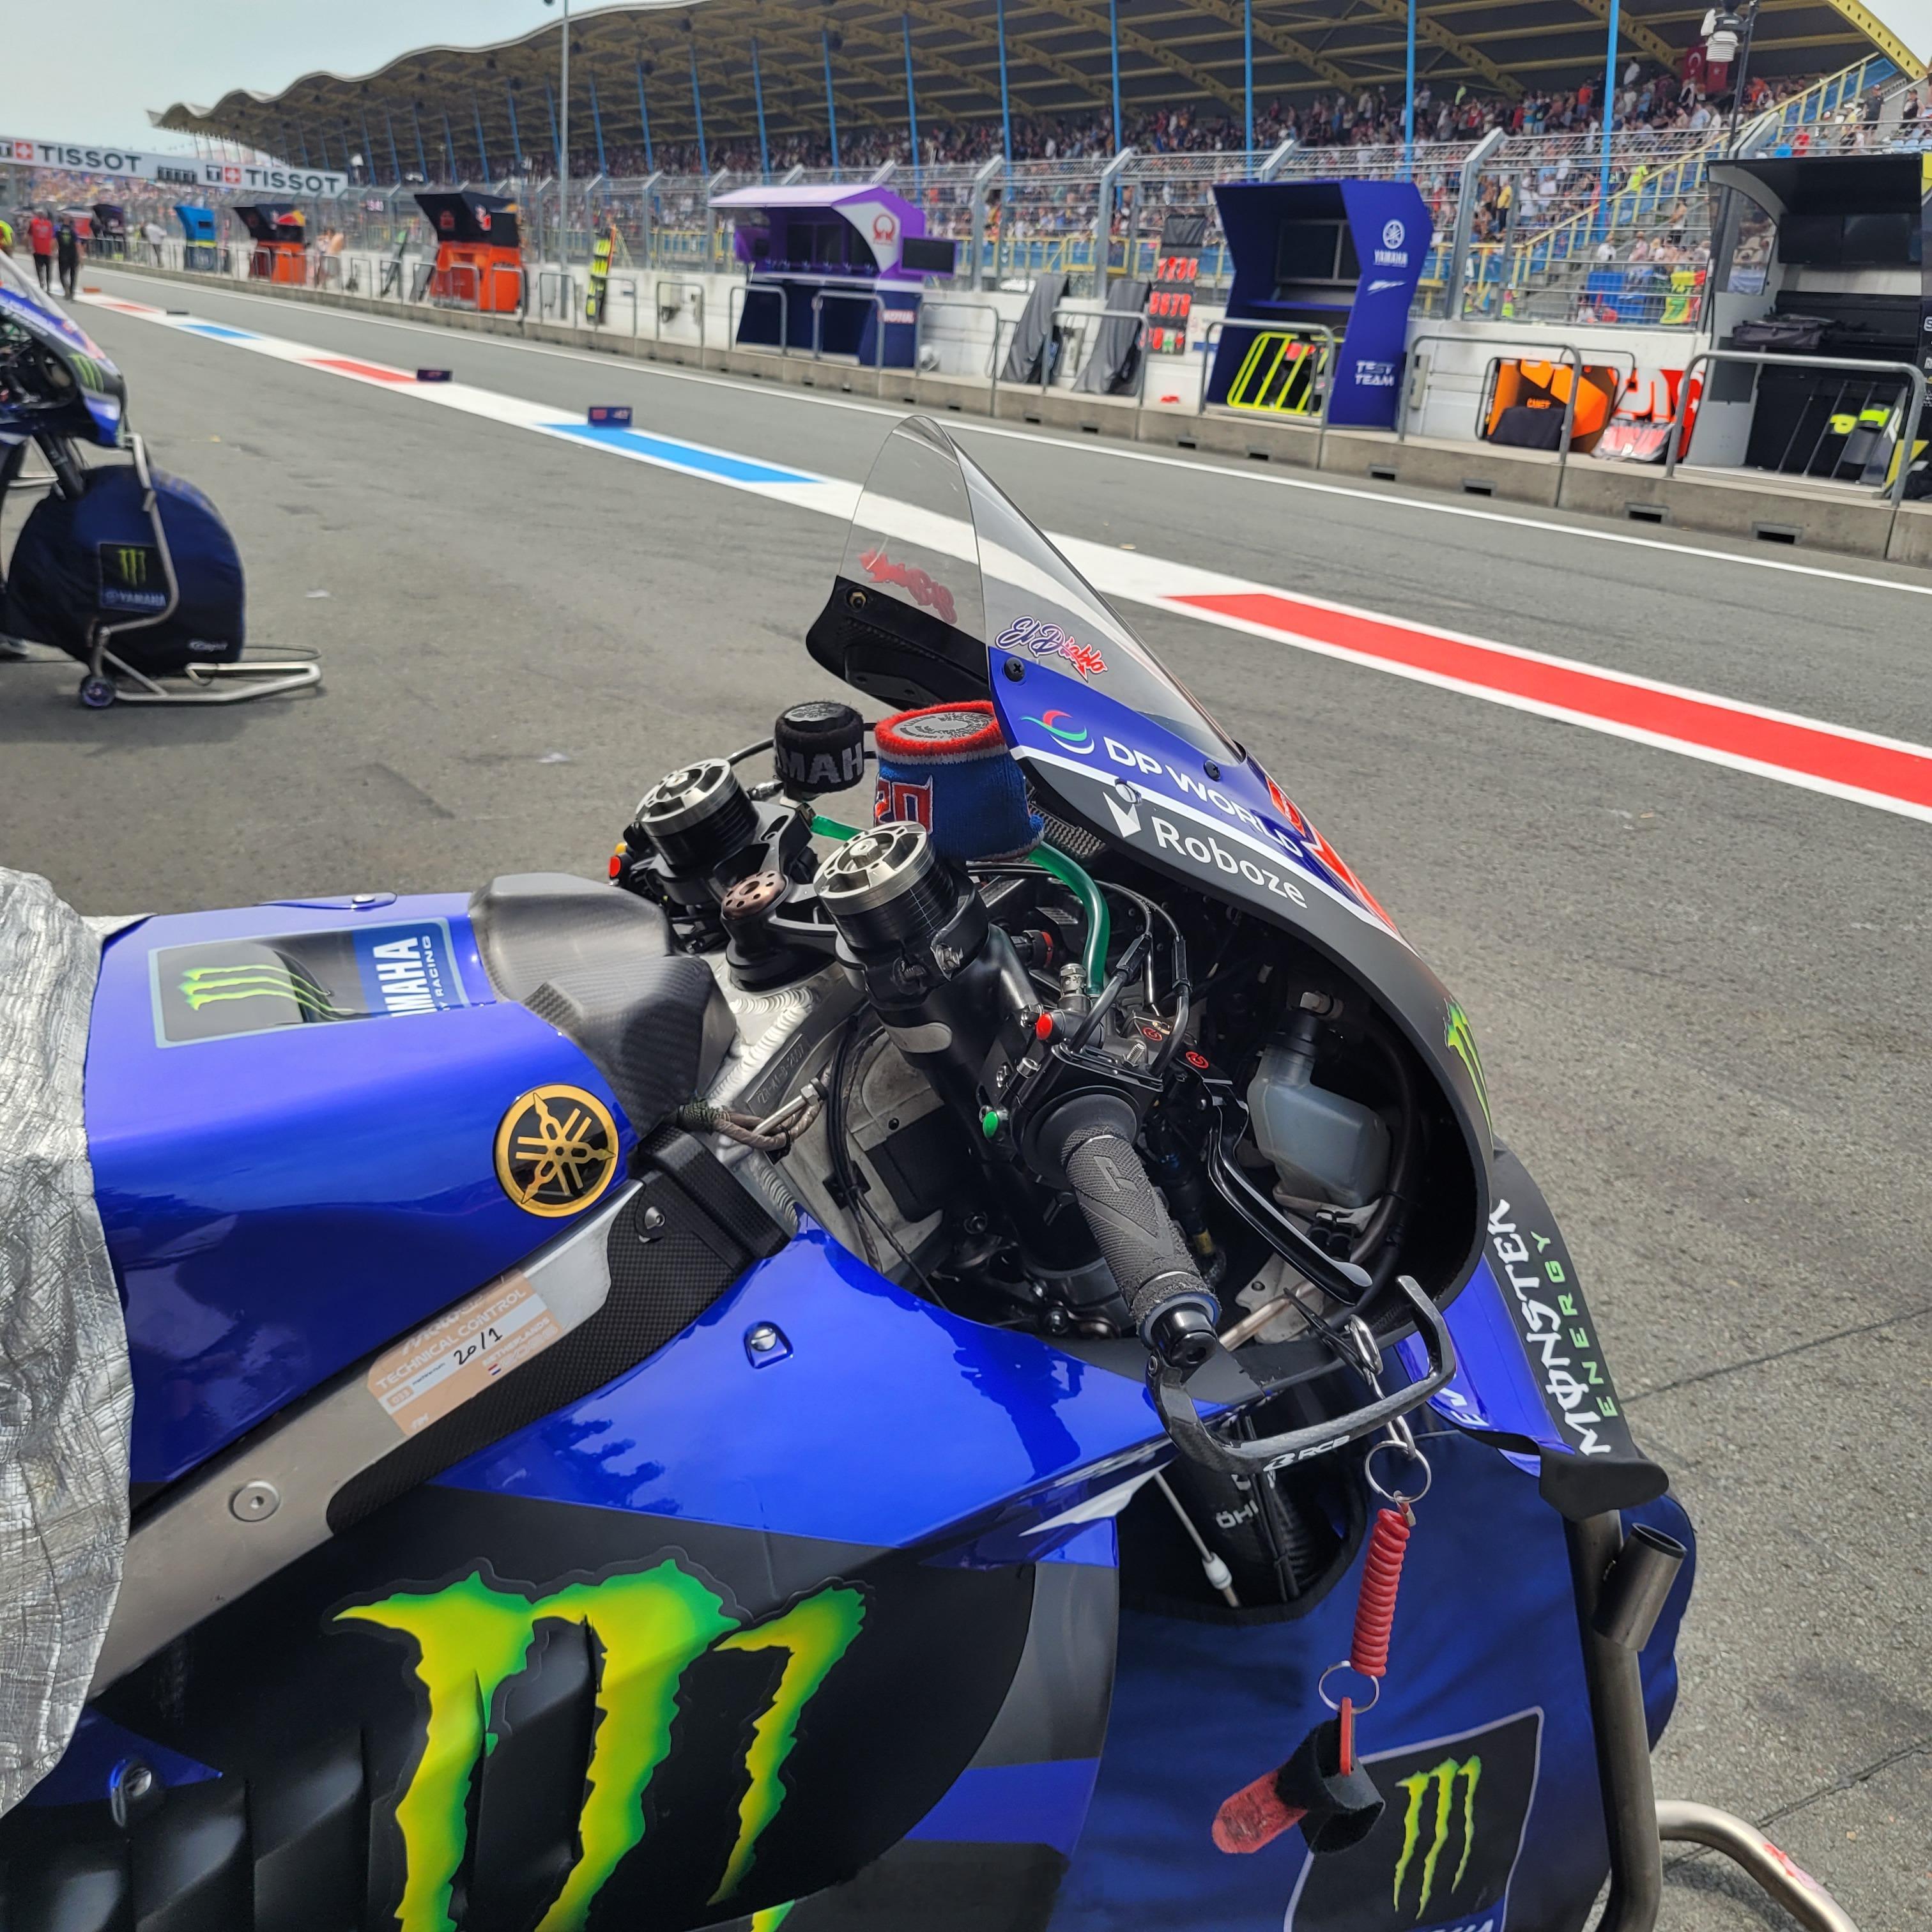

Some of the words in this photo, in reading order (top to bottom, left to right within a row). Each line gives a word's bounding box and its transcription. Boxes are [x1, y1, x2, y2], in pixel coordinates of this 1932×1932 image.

[38, 144, 142, 172] TISSOT
[245, 169, 341, 193] TISSOT
[1374, 249, 1409, 265] YAMAHA
[1355, 374, 1395, 387] TEAM
[1356, 360, 1395, 374] TEST
[995, 615, 1038, 651] El
[1029, 623, 1108, 681] Diablo
[1102, 736, 1163, 775] DP
[1165, 767, 1304, 858] WORLD
[1151, 816, 1308, 909] Roboze
[373, 937, 438, 1018] MAHA
[422, 935, 445, 997] RACING
[376, 1335, 460, 1389] TECHNICAL
[457, 1288, 527, 1337] CONTROL
[453, 1327, 503, 1366] 20/1
[482, 1316, 551, 1367] NETHERLANDS
[1487, 1199, 1612, 1457] MONSTER
[1531, 1230, 1618, 1417] ENERGY
